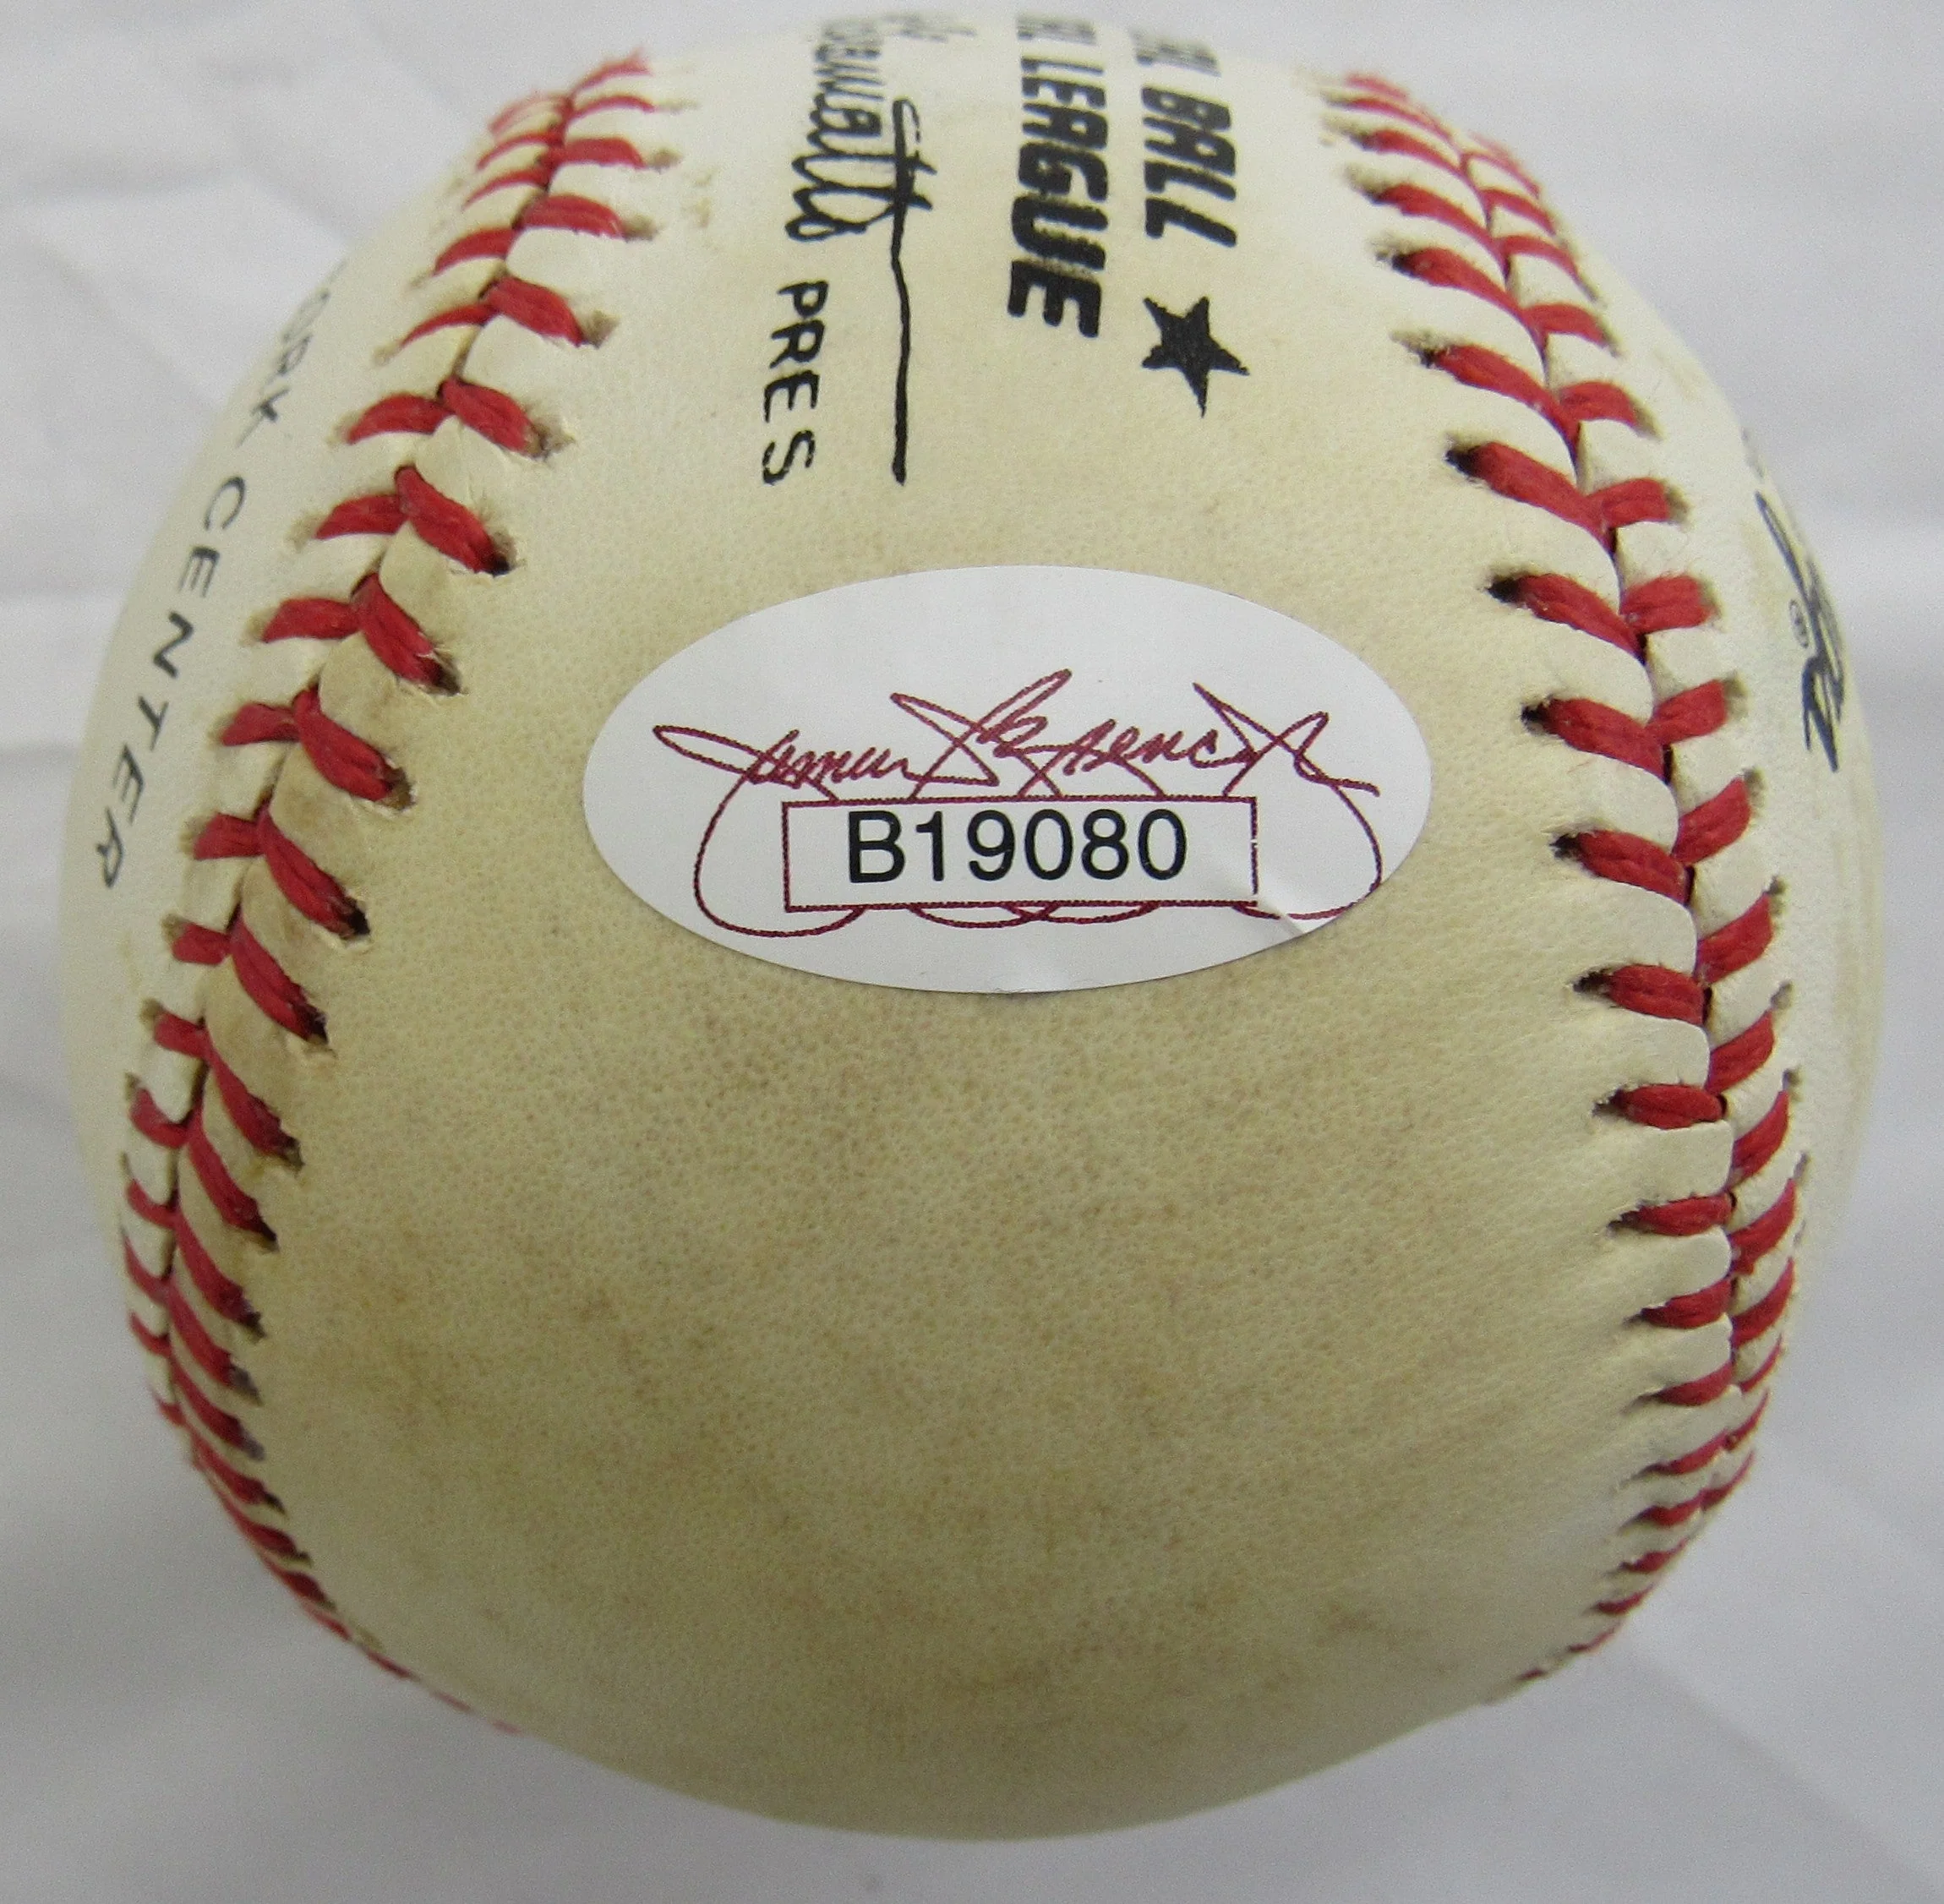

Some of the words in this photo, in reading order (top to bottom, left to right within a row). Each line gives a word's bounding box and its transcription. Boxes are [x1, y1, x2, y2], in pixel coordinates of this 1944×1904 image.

[1007, 56, 1109, 339] LEAGUE
[1140, 85, 1237, 248] BALL
[237, 259, 347, 449] ORK
[762, 280, 829, 486] PRES
[95, 475, 247, 890] CENTER
[846, 807, 1188, 886] B19080
